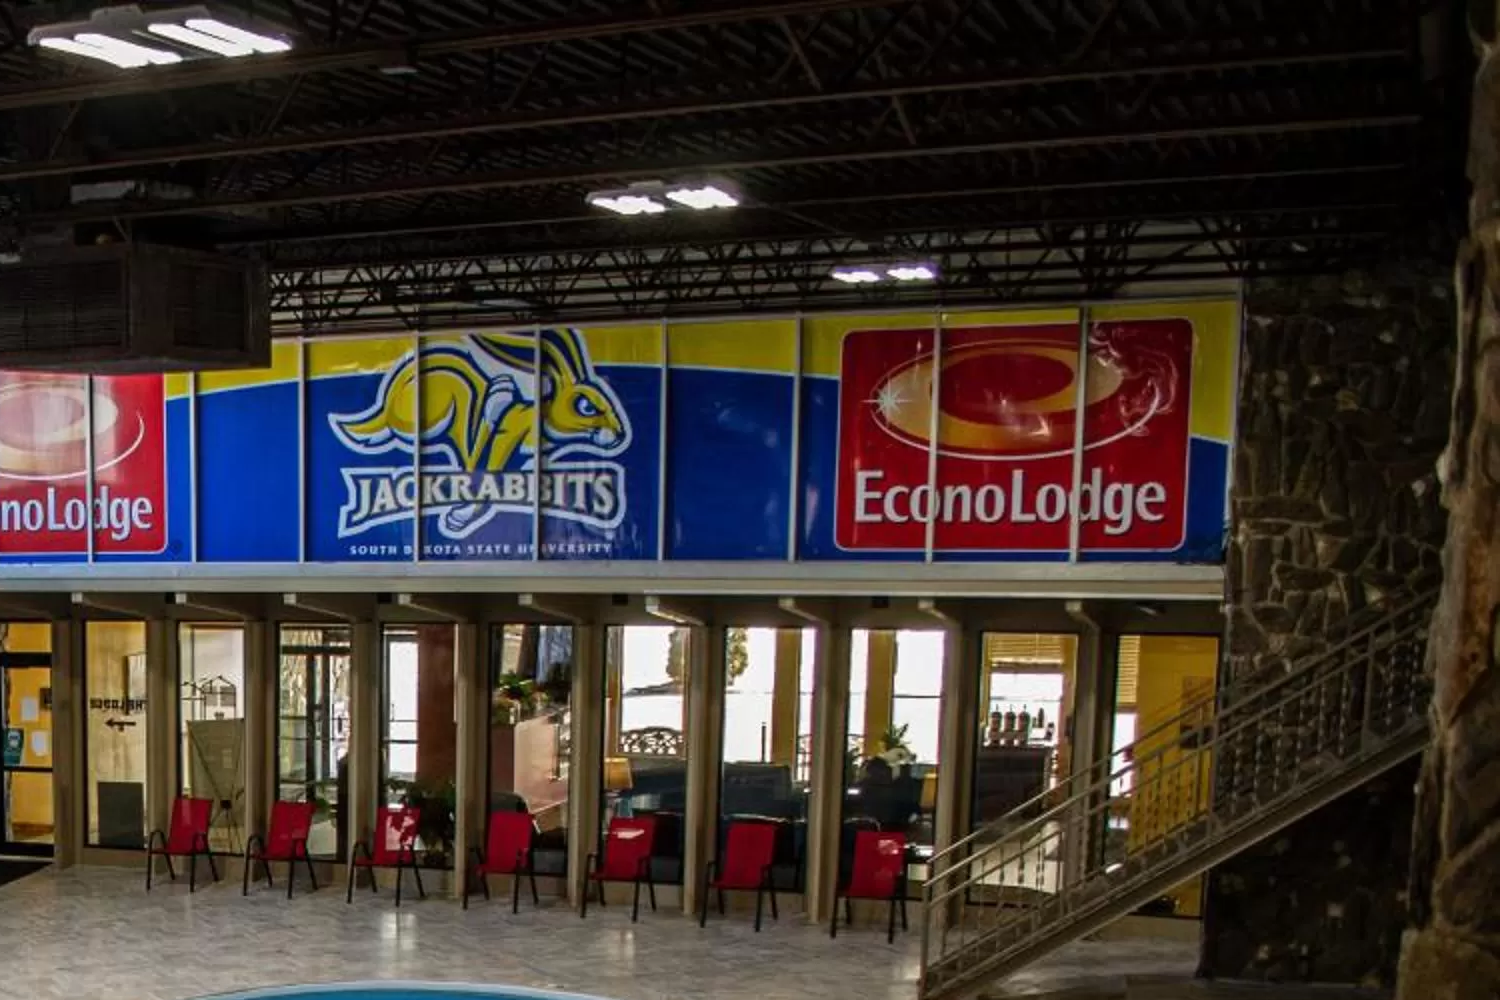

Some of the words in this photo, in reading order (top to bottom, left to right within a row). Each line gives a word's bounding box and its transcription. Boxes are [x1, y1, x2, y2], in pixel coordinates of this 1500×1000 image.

[351, 472, 614, 523] JACKRABBITS
[349, 545, 397, 556] SOUTH
[403, 545, 461, 556] DKOTA
[467, 544, 511, 555] STATE
